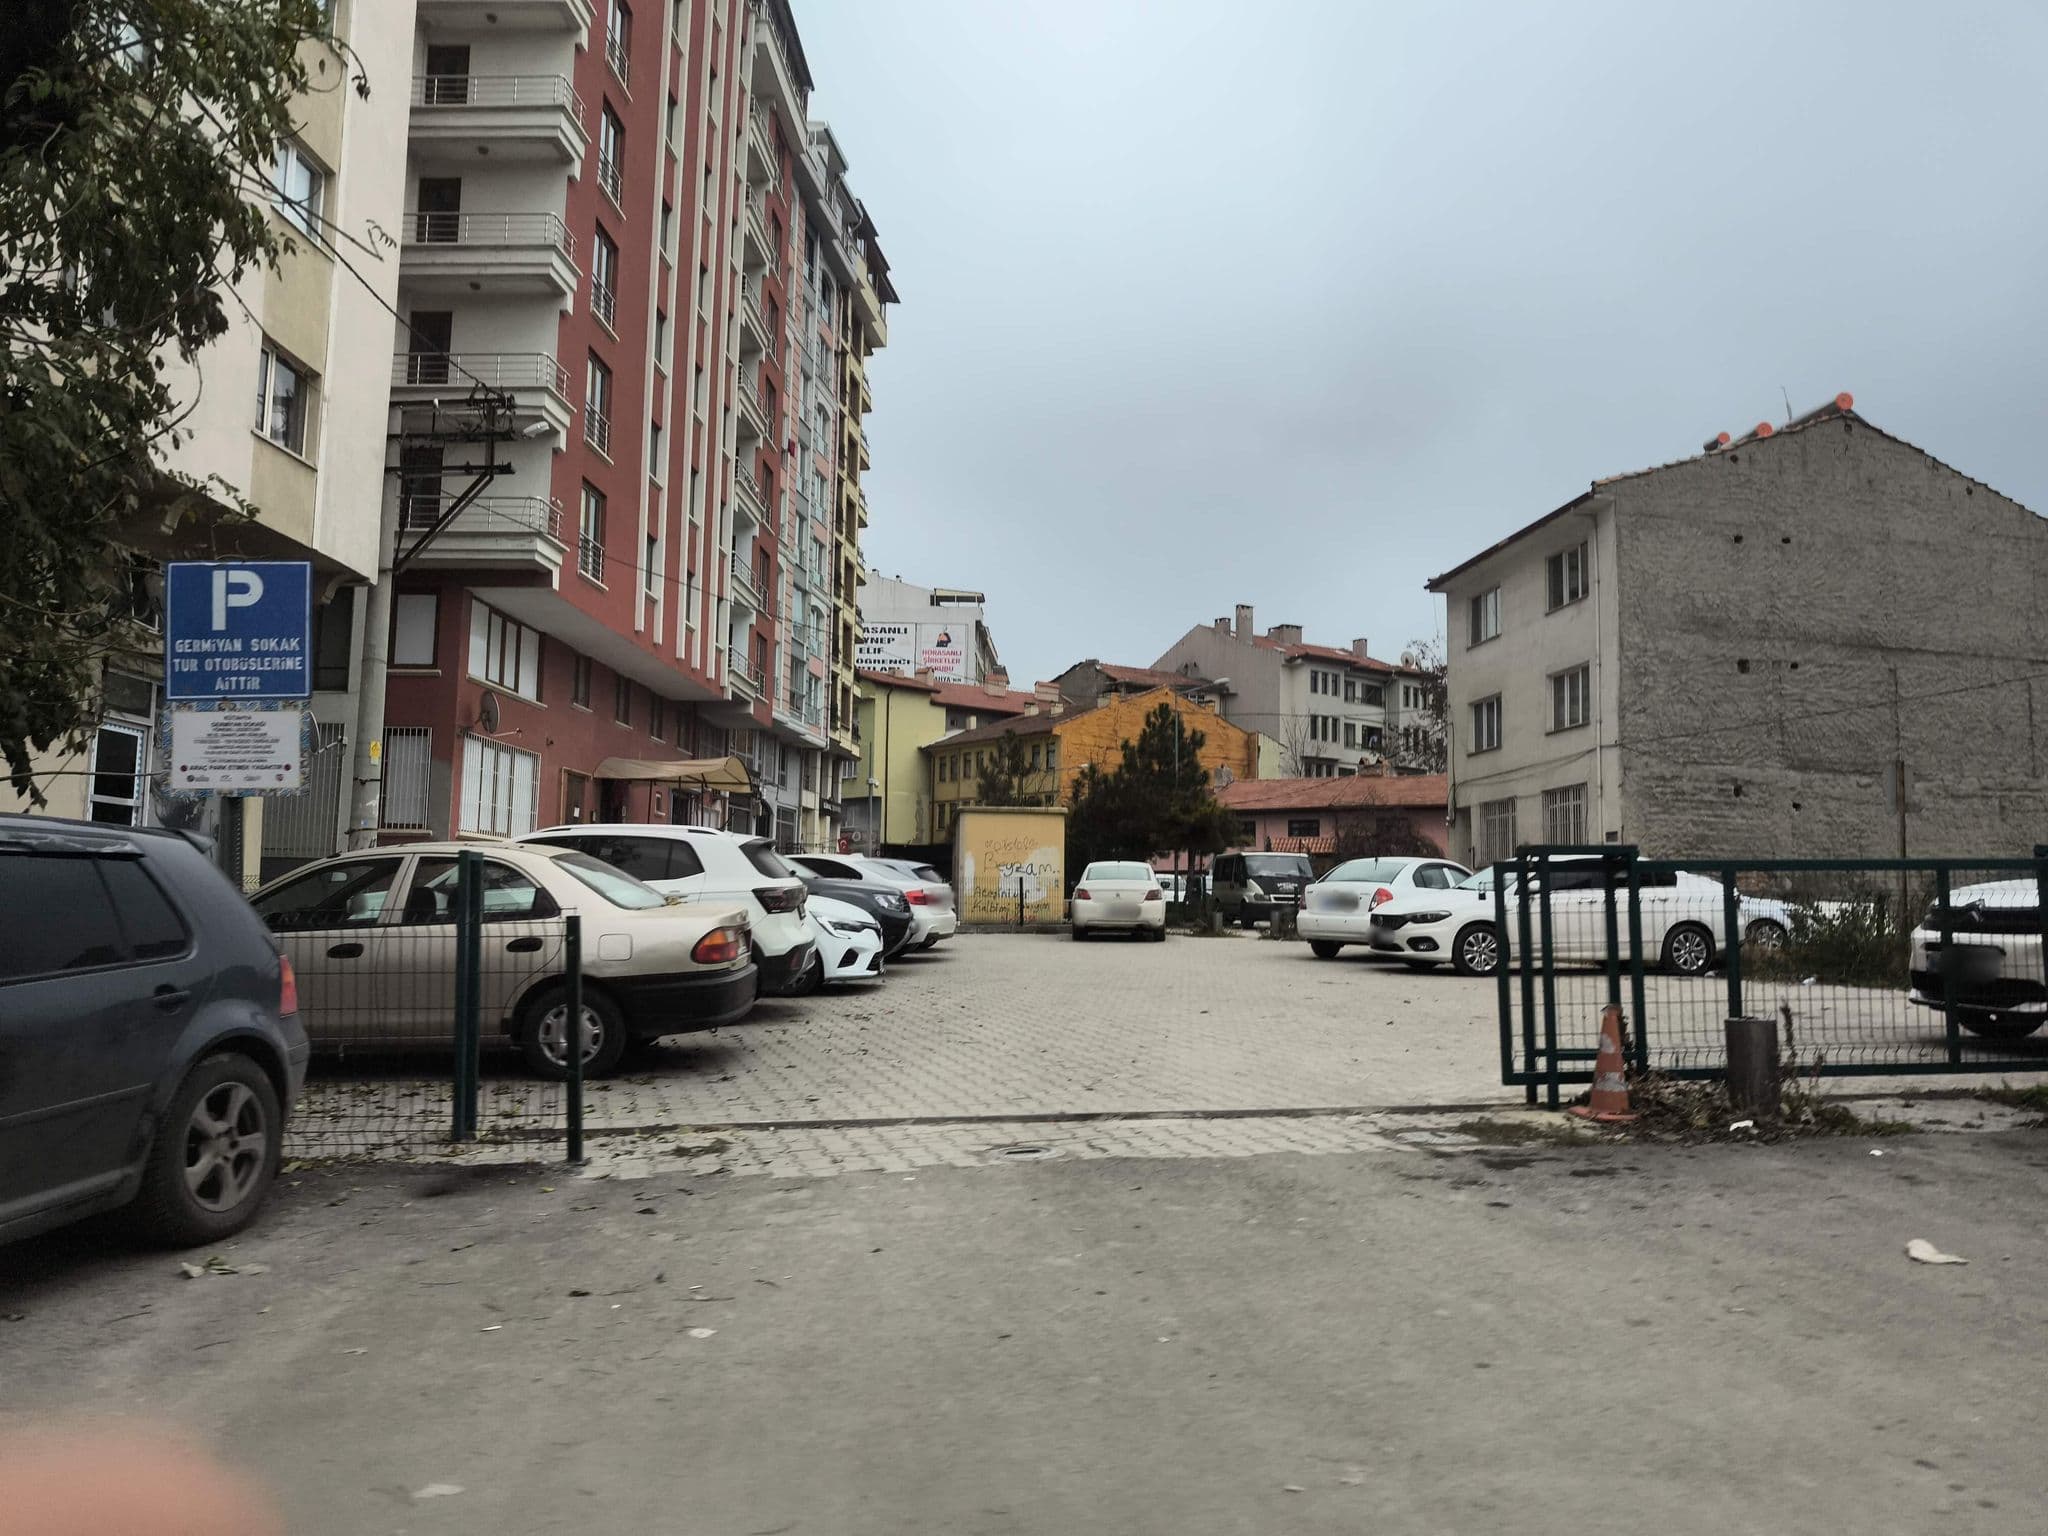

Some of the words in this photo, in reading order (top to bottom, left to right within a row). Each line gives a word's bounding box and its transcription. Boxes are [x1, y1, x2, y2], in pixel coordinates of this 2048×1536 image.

[211, 569, 264, 631] P
[863, 626, 908, 634] ASANLI
[250, 637, 301, 652] SOKAK
[173, 658, 199, 672] TUR
